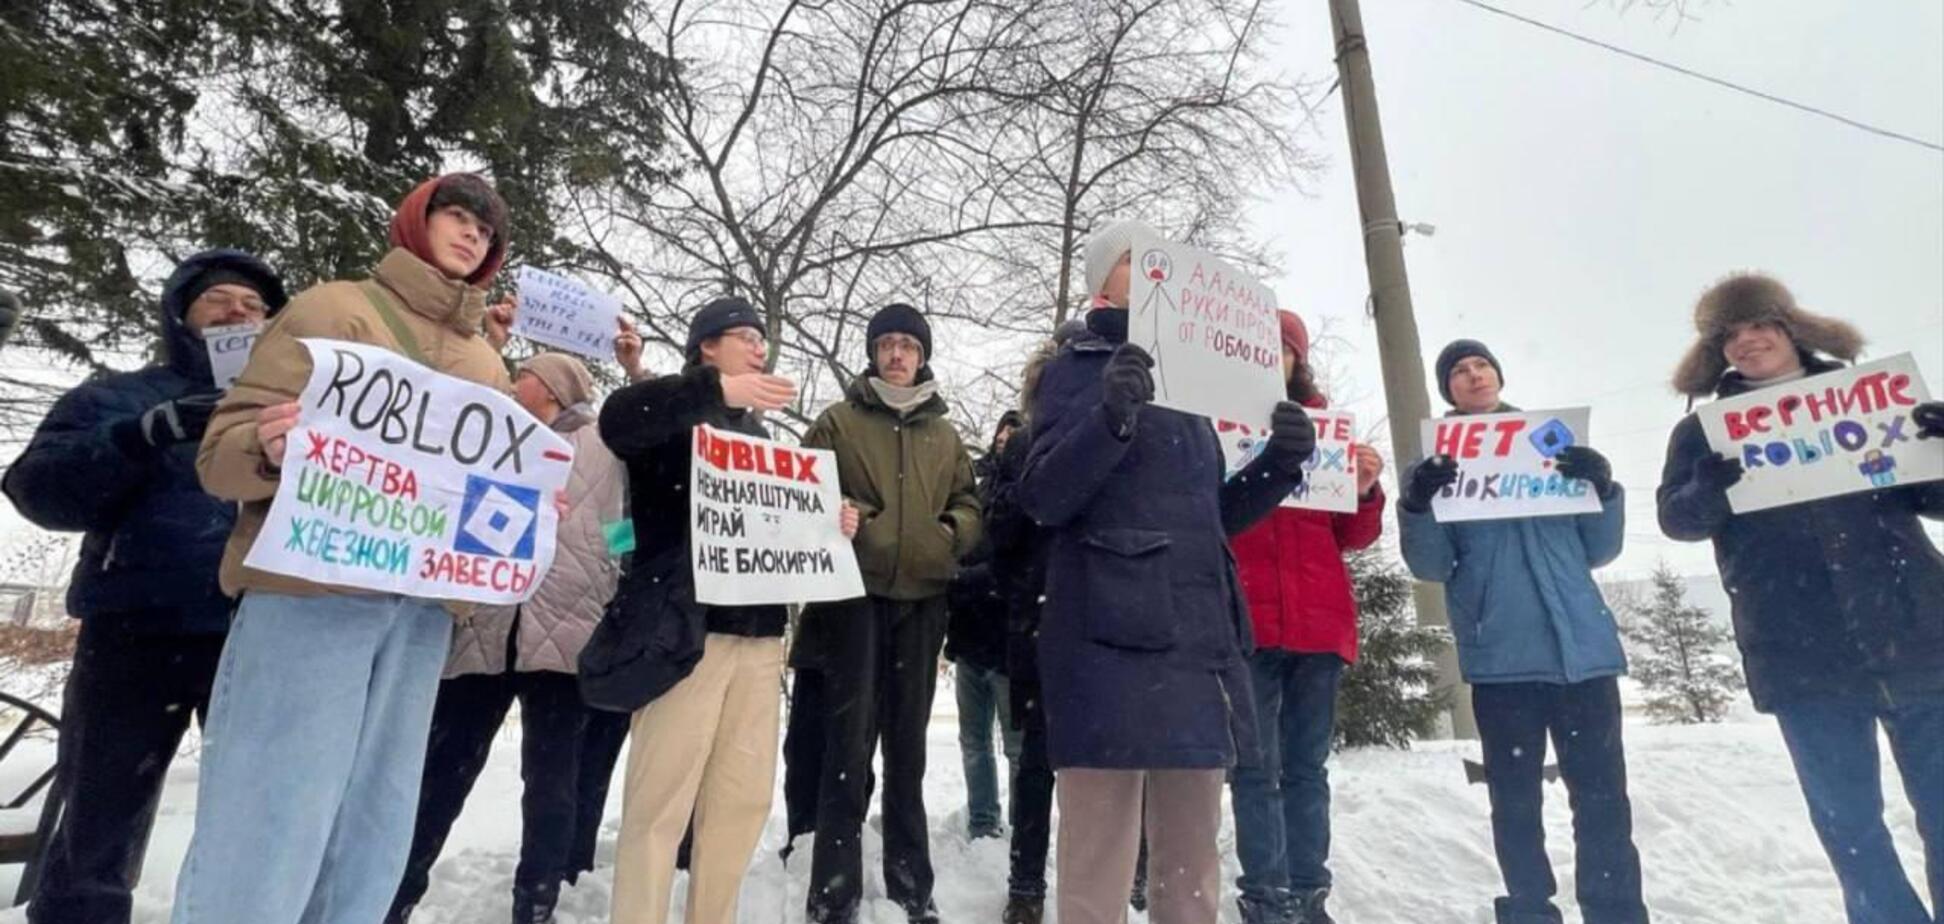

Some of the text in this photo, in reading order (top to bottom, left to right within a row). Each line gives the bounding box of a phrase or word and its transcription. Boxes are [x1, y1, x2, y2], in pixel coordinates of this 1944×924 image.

[1181, 287, 1229, 323] РУКИ
[1178, 322, 1195, 343] ОТ
[317, 349, 537, 474] ROBLOX
[698, 426, 820, 484] ROBLOX
[1435, 419, 1526, 461] НЕТ
[305, 430, 418, 502] ЖЕРТВА
[297, 465, 447, 538] ЦИФРОВОЙ
[698, 467, 824, 514] НЕЖНАЯ ШТУЧКА
[697, 504, 745, 537] ИГРАЙ
[419, 548, 537, 593] ЗАВЕСЫ
[735, 548, 835, 574] БЛОКИРУЙ
